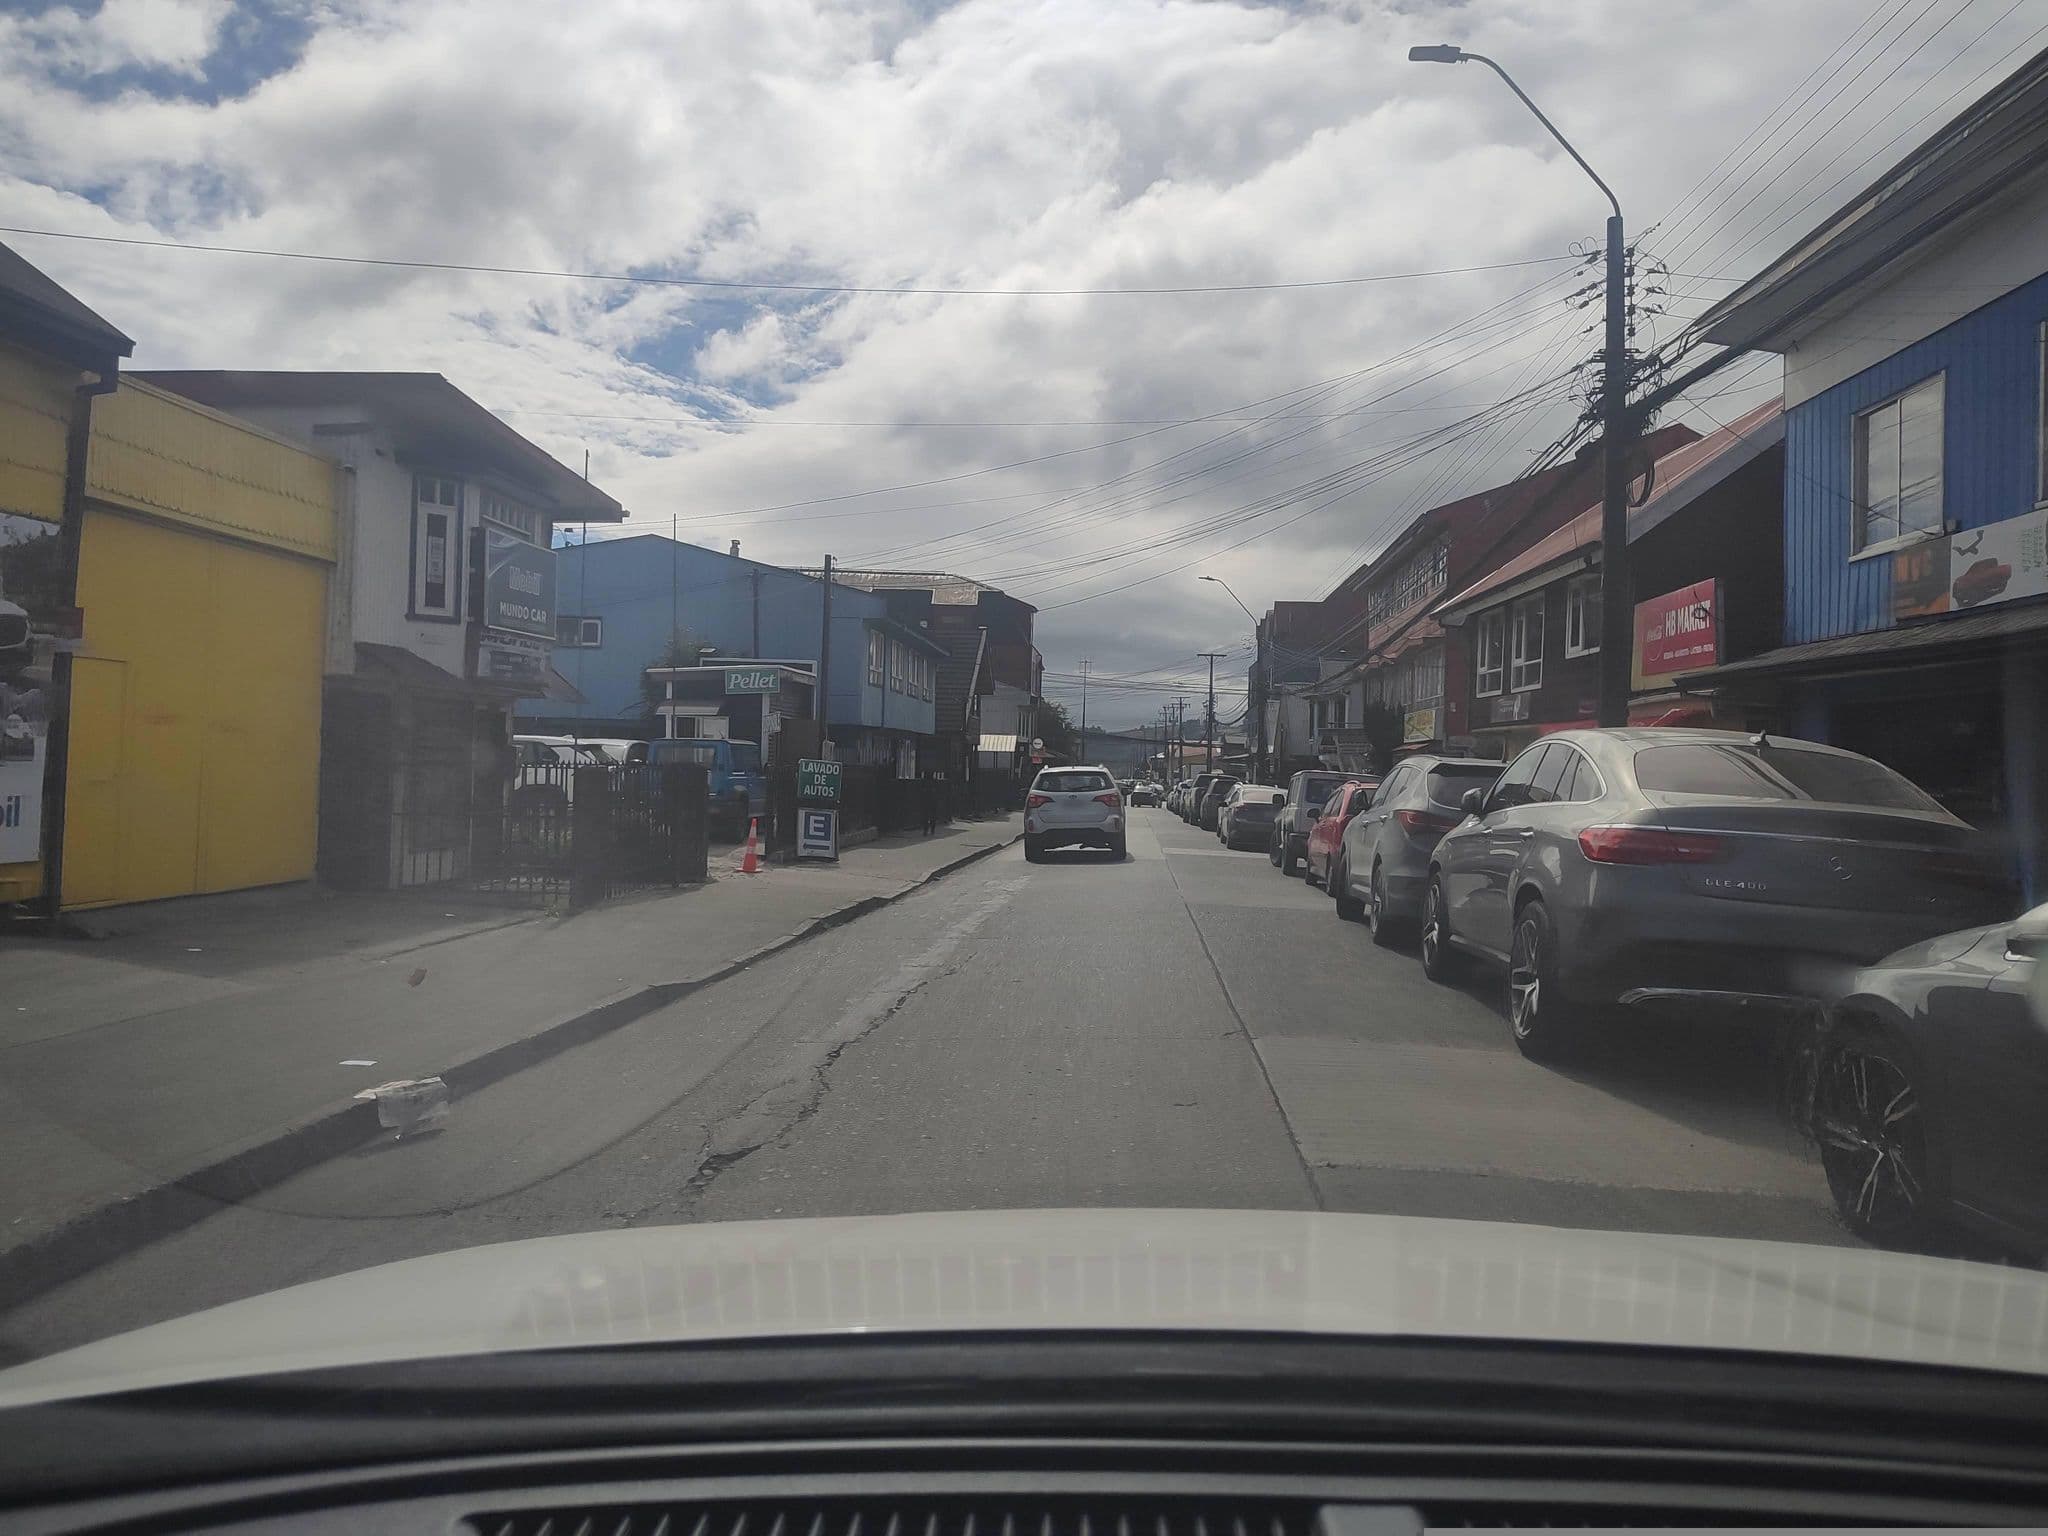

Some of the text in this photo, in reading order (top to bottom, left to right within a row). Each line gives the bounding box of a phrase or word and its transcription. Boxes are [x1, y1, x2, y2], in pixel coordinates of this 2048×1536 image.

[500, 601, 547, 625] MUNDO CAR
[1665, 609, 1677, 637] HB
[1677, 599, 1711, 635] MARKET
[729, 672, 776, 690] Pellet
[802, 761, 840, 776] LAVADO
[814, 773, 827, 786] DE
[804, 785, 834, 798] AUTOS
[809, 815, 825, 837] E
